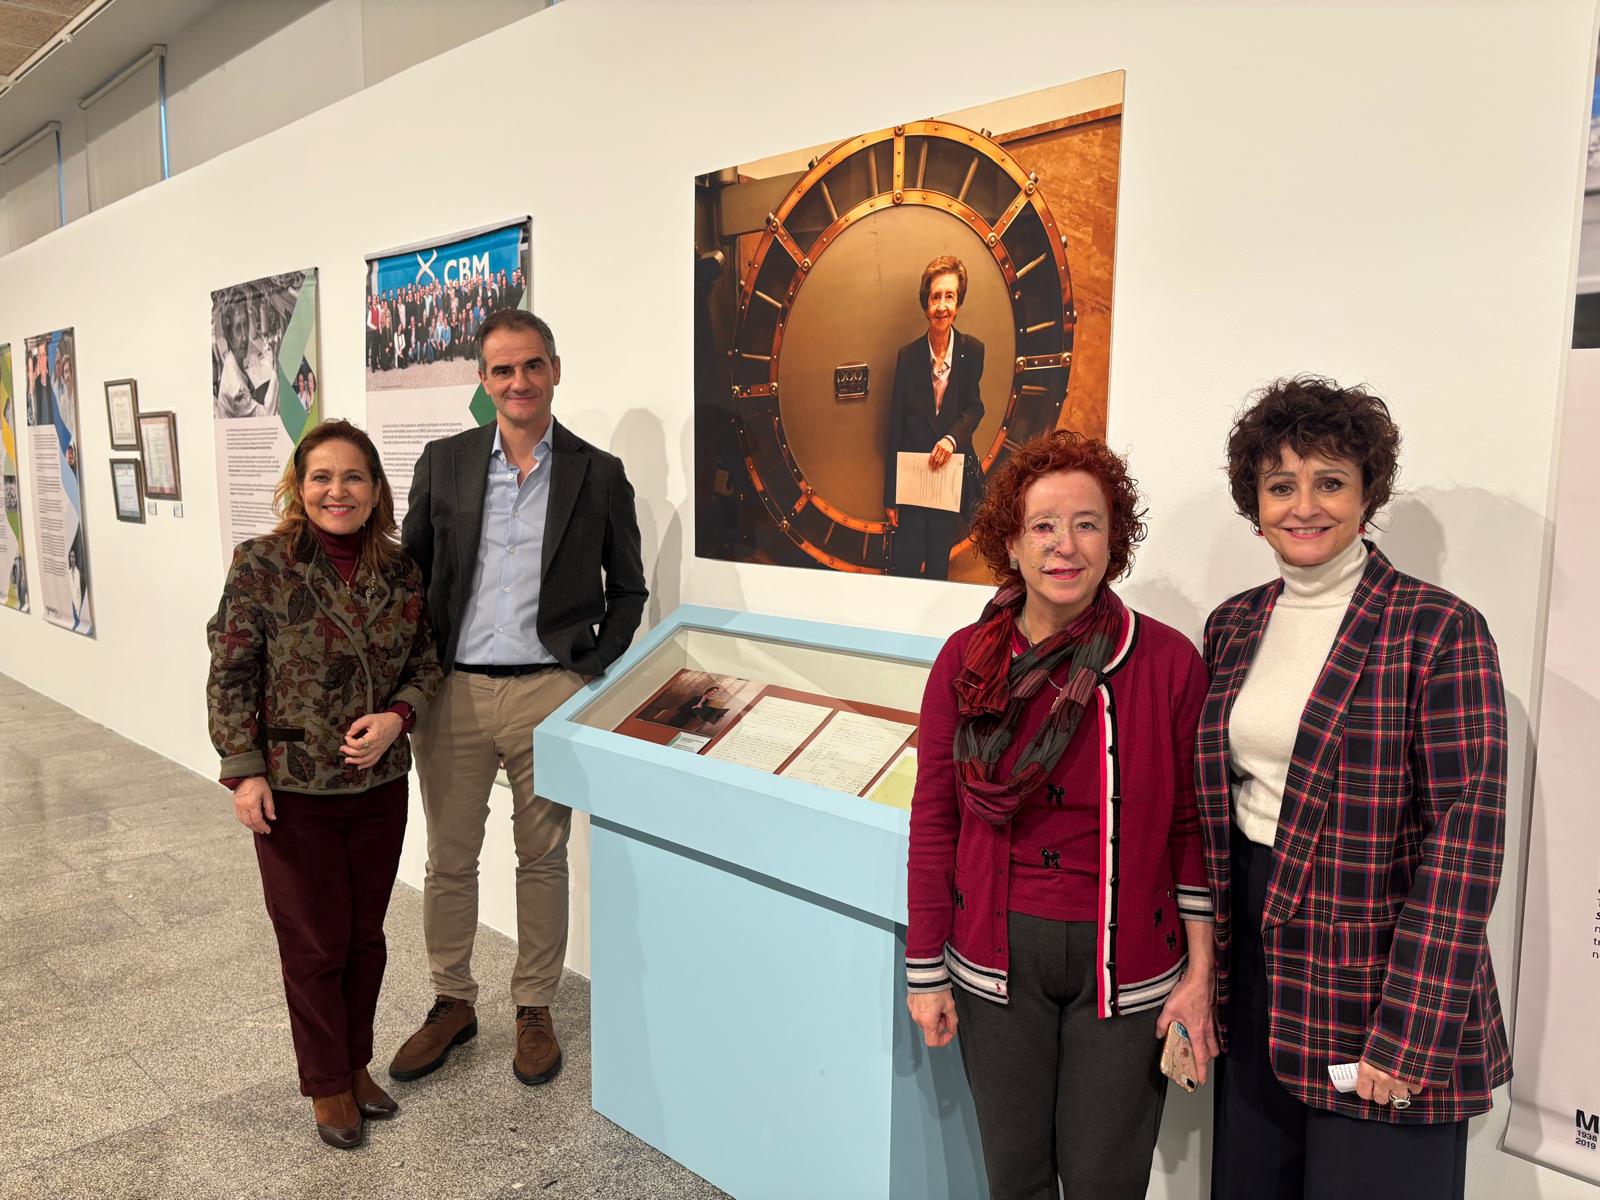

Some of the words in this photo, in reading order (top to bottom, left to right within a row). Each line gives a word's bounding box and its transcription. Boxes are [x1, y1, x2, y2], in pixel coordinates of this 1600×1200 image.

[444, 251, 490, 287] CBM
[1577, 1130, 1597, 1142] 1938
[1575, 1137, 1597, 1150] 2019
